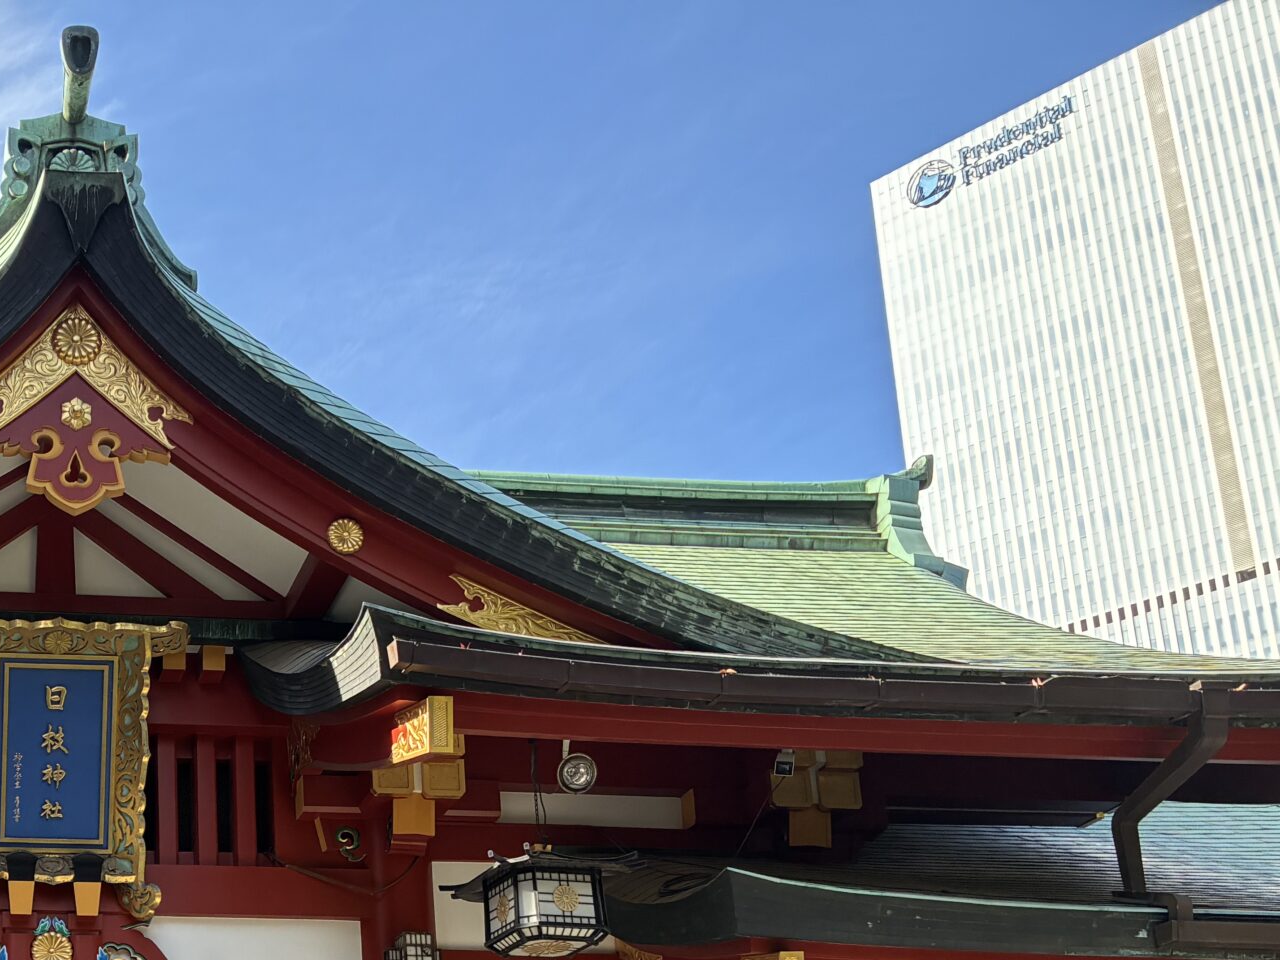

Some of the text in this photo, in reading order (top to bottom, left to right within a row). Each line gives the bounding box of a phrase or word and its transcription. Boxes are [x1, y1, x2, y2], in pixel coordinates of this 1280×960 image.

[958, 95, 1074, 166] Prudential
[961, 121, 1063, 187] Financial
[40, 684, 69, 820] 日枝神社
